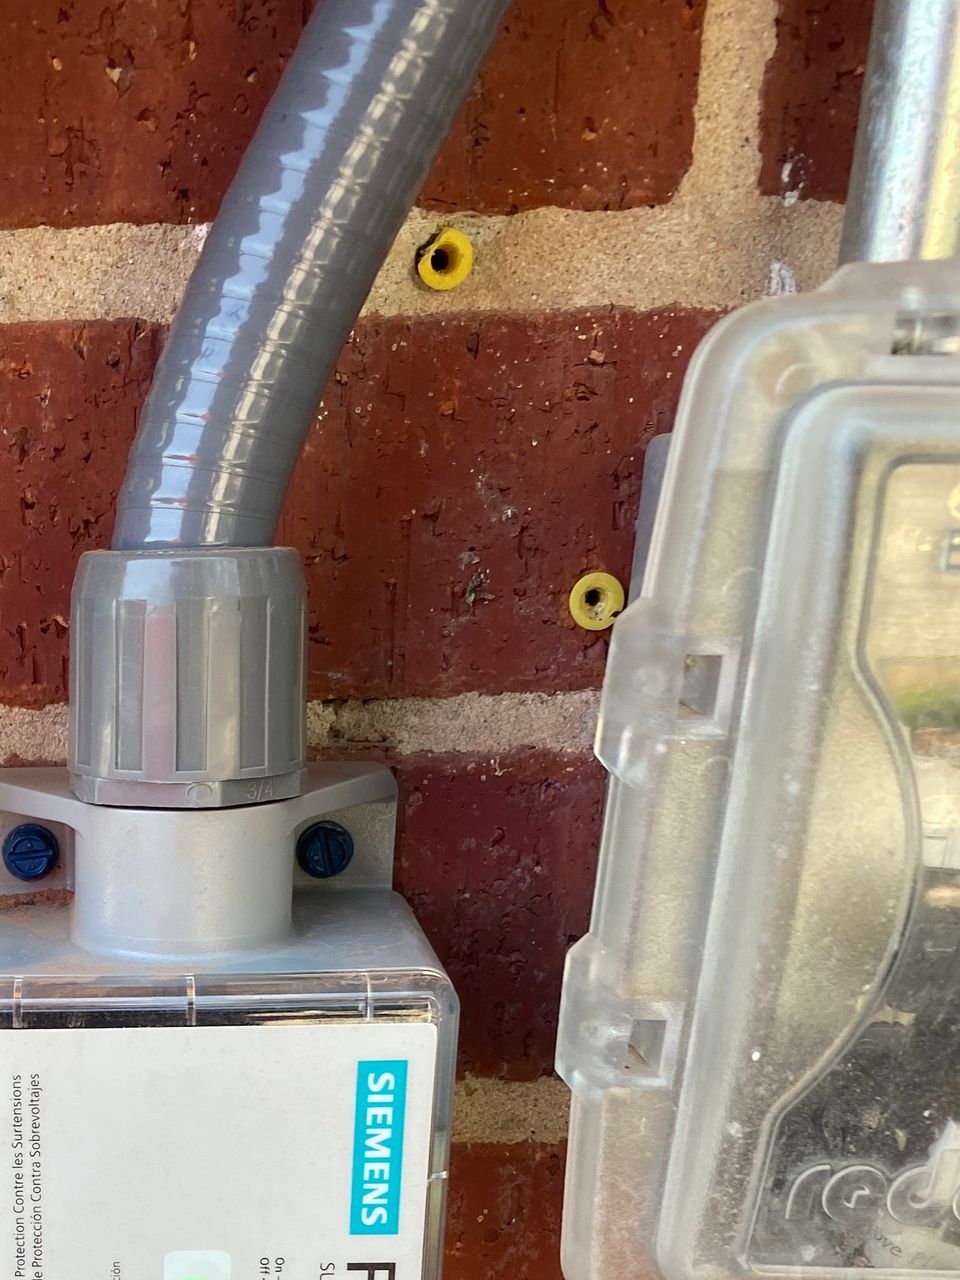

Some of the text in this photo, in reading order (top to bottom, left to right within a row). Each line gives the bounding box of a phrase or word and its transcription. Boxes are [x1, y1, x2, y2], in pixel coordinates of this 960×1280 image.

[9, 1074, 22, 1148] Surtensions
[27, 1073, 42, 1157] Sobrevoltajes
[11, 1152, 23, 1168] les
[361, 1072, 394, 1225] SIEMENS
[785, 1122, 960, 1228] red
[12, 1172, 24, 1213] Contre
[30, 1161, 41, 1201] Contra
[13, 1217, 25, 1276] Protection
[30, 1205, 42, 1267] Protección
[259, 1257, 270, 1274] Off
[274, 1257, 285, 1272] On
